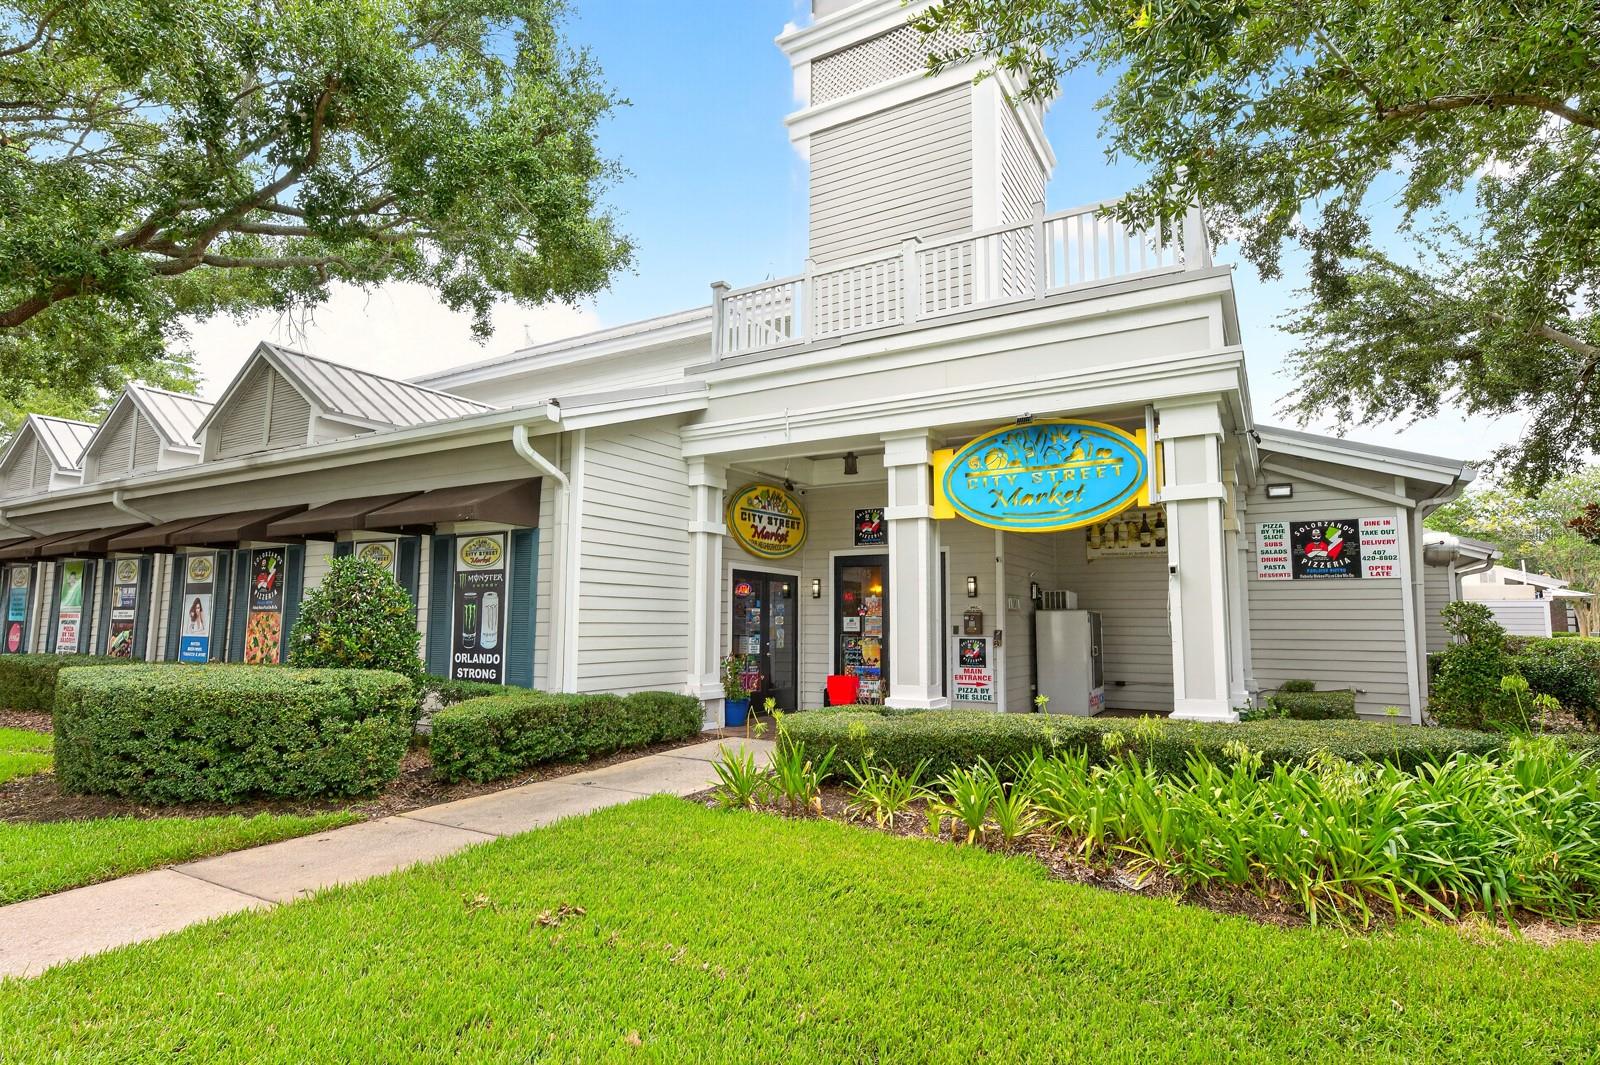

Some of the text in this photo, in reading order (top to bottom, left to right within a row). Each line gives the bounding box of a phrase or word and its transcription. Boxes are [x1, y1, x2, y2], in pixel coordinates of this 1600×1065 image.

[967, 464, 1124, 490] CITY STREET
[988, 480, 1087, 509] Market
[740, 511, 801, 530] CITY STREET
[750, 524, 790, 543] Market
[1294, 521, 1355, 537] SOLORZANO'S
[470, 556, 491, 564] Market
[1301, 557, 1351, 569] PIZZERIA
[467, 573, 503, 582] MONSTER
[454, 653, 501, 665] ORLANDO
[456, 668, 497, 680] STRONG
